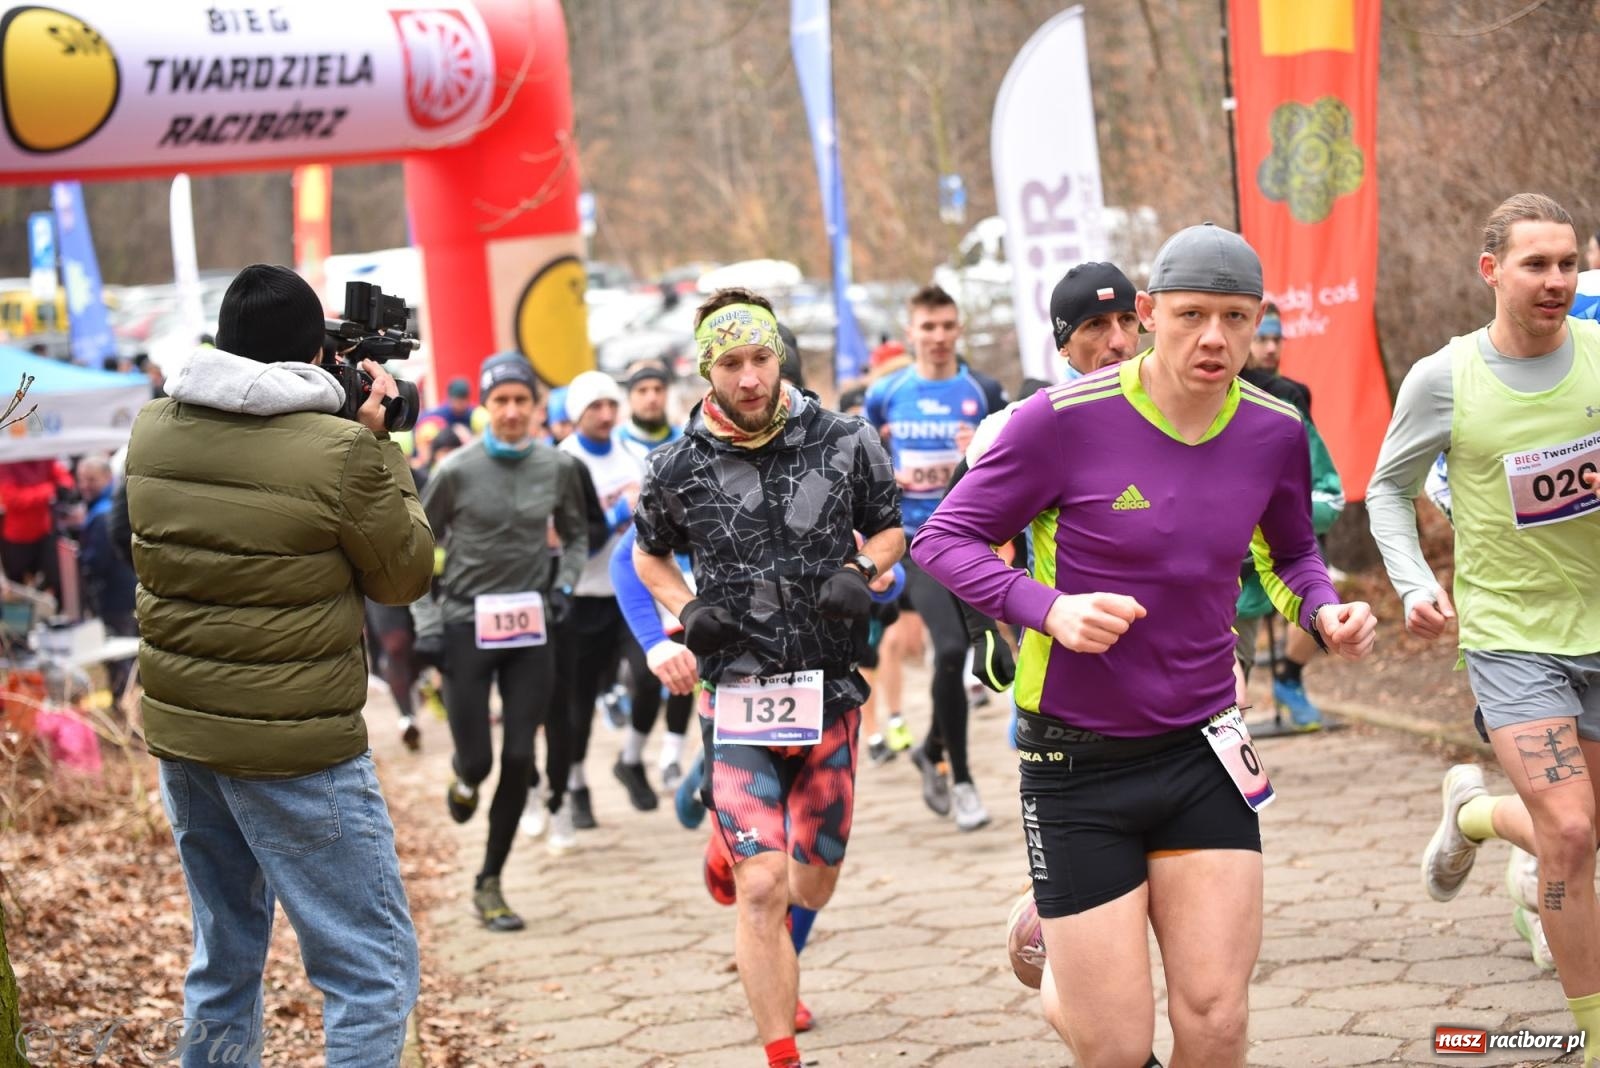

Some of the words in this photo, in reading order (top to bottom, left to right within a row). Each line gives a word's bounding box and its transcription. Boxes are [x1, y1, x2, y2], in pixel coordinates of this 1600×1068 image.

[206, 8, 290, 33] BIEG
[146, 53, 375, 94] TWARDZIELA
[158, 101, 349, 147] RACIBÓRZ
[1514, 453, 1541, 465] BIEG
[1112, 500, 1150, 510] adidas
[494, 611, 529, 631] 130
[743, 697, 796, 723] 132
[1046, 751, 1064, 761] 10
